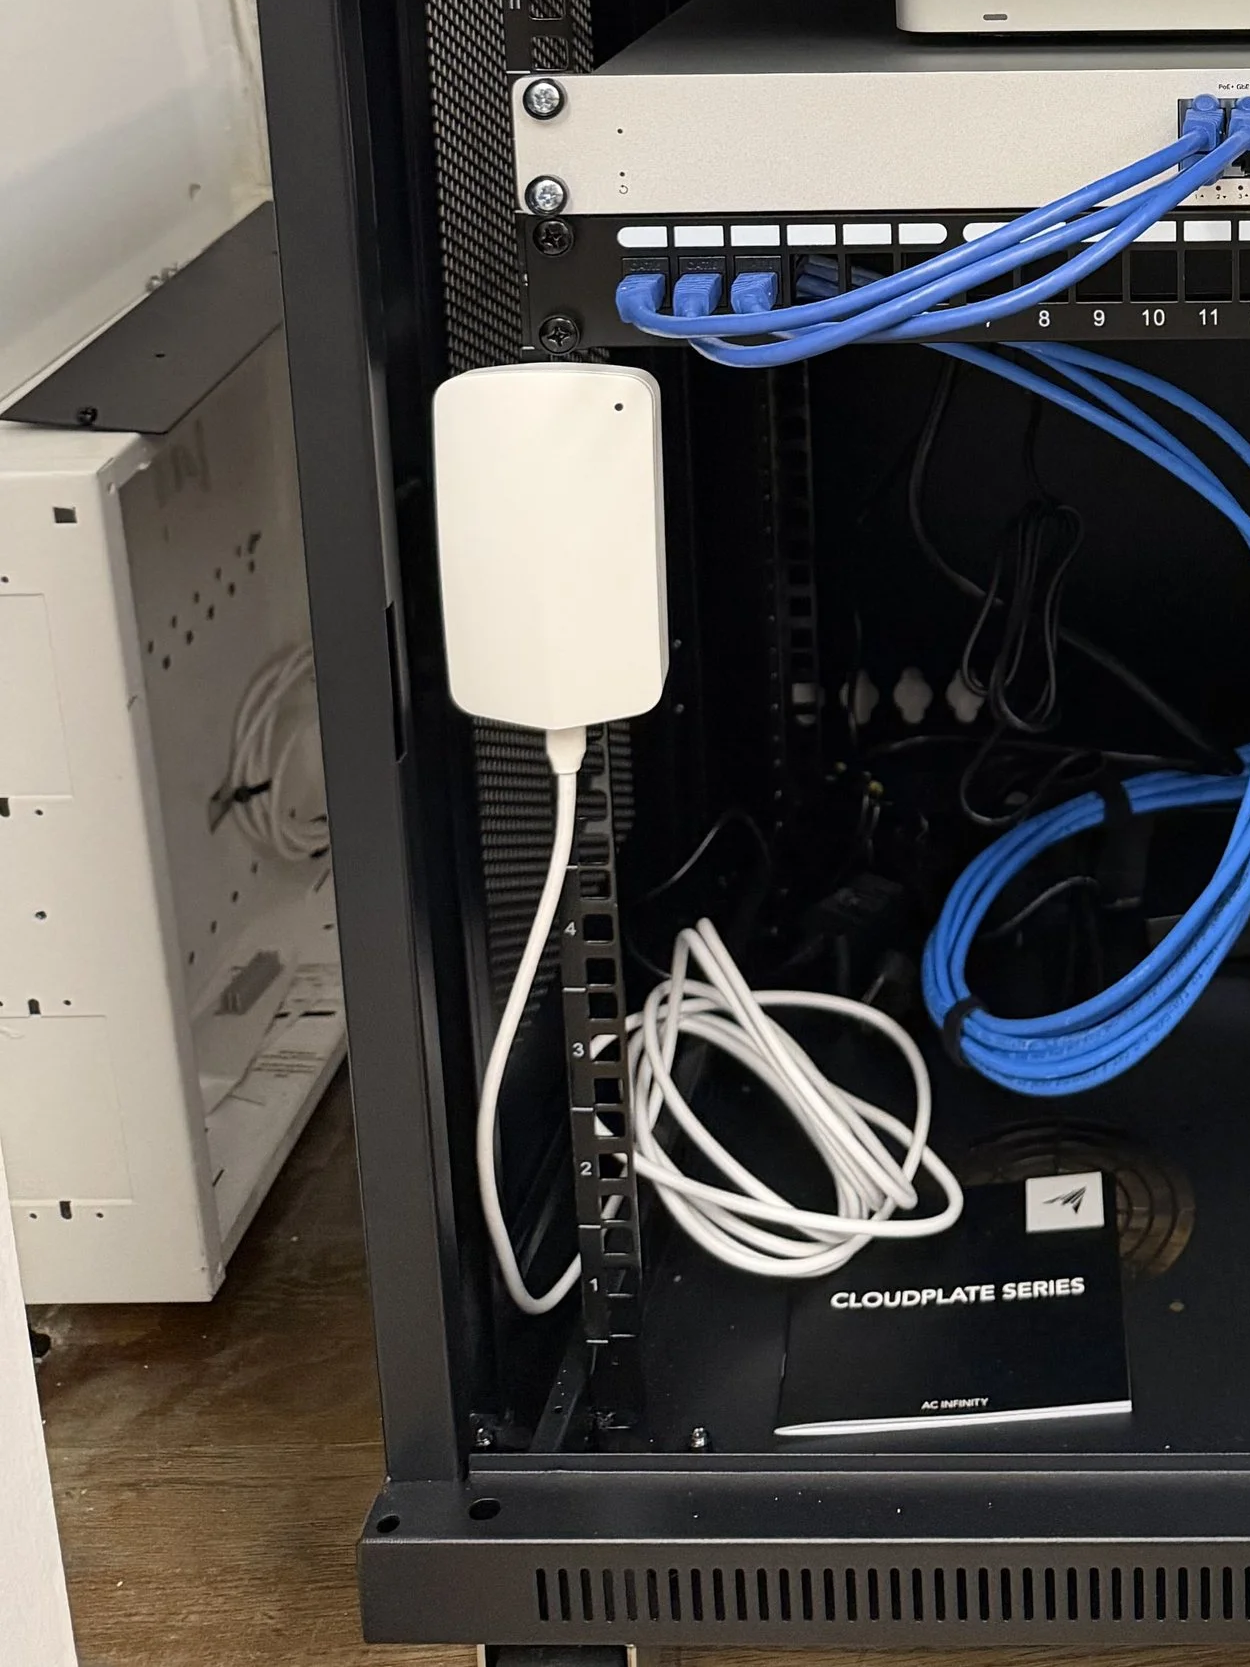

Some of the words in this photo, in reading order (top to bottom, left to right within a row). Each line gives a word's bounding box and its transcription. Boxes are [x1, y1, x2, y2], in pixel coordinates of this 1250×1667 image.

[1039, 310, 1050, 327] 8
[1094, 310, 1104, 326] 9
[1143, 309, 1164, 325] 10
[1199, 309, 1217, 325] 11
[565, 922, 576, 935] 4
[573, 1043, 584, 1057] 3
[581, 1162, 591, 1175] 2
[590, 1278, 597, 1291] 1
[831, 1285, 995, 1308] CLOUDPLATE
[1003, 1278, 1084, 1299] SERIES
[922, 1401, 938, 1409] AC
[941, 1398, 988, 1408] INFINITY
